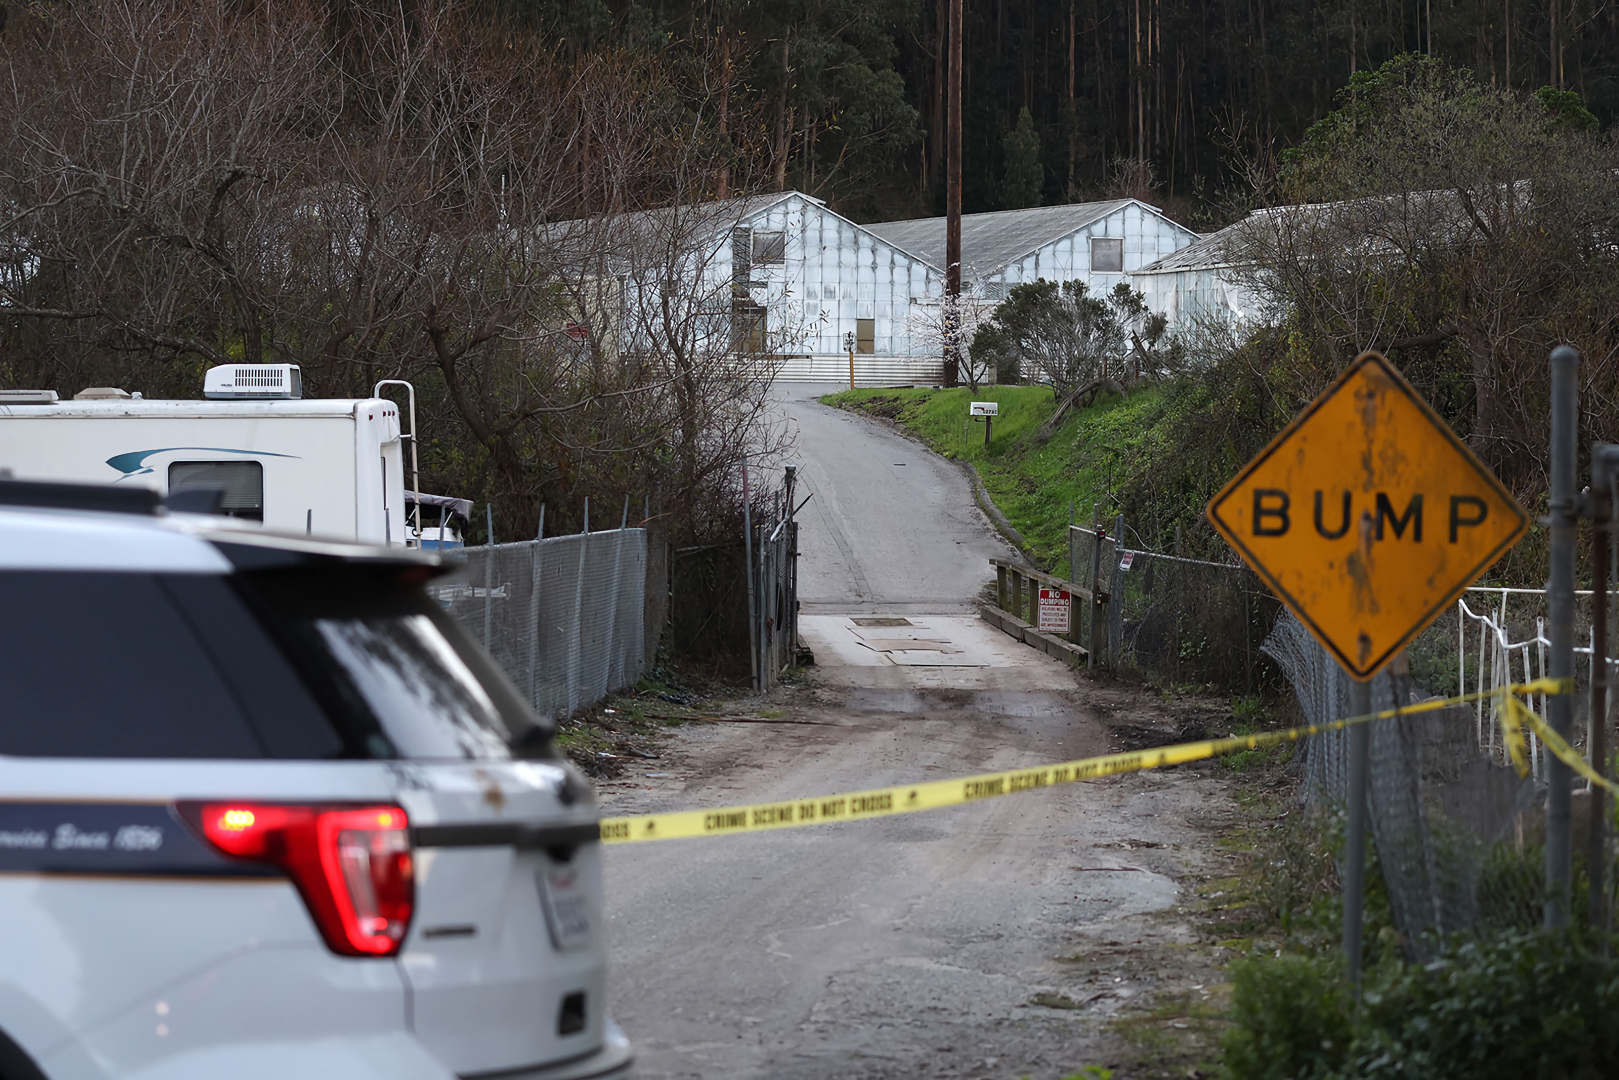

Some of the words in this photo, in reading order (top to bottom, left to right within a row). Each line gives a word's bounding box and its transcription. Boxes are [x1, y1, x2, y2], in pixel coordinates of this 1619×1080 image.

[1252, 488, 1488, 544] BUMP
[1048, 590, 1061, 599] NO
[705, 812, 746, 830] CRIME
[753, 805, 793, 825] SCENE
[799, 802, 816, 820] DO
[821, 798, 846, 817] NOT
[851, 793, 893, 814] CROSS
